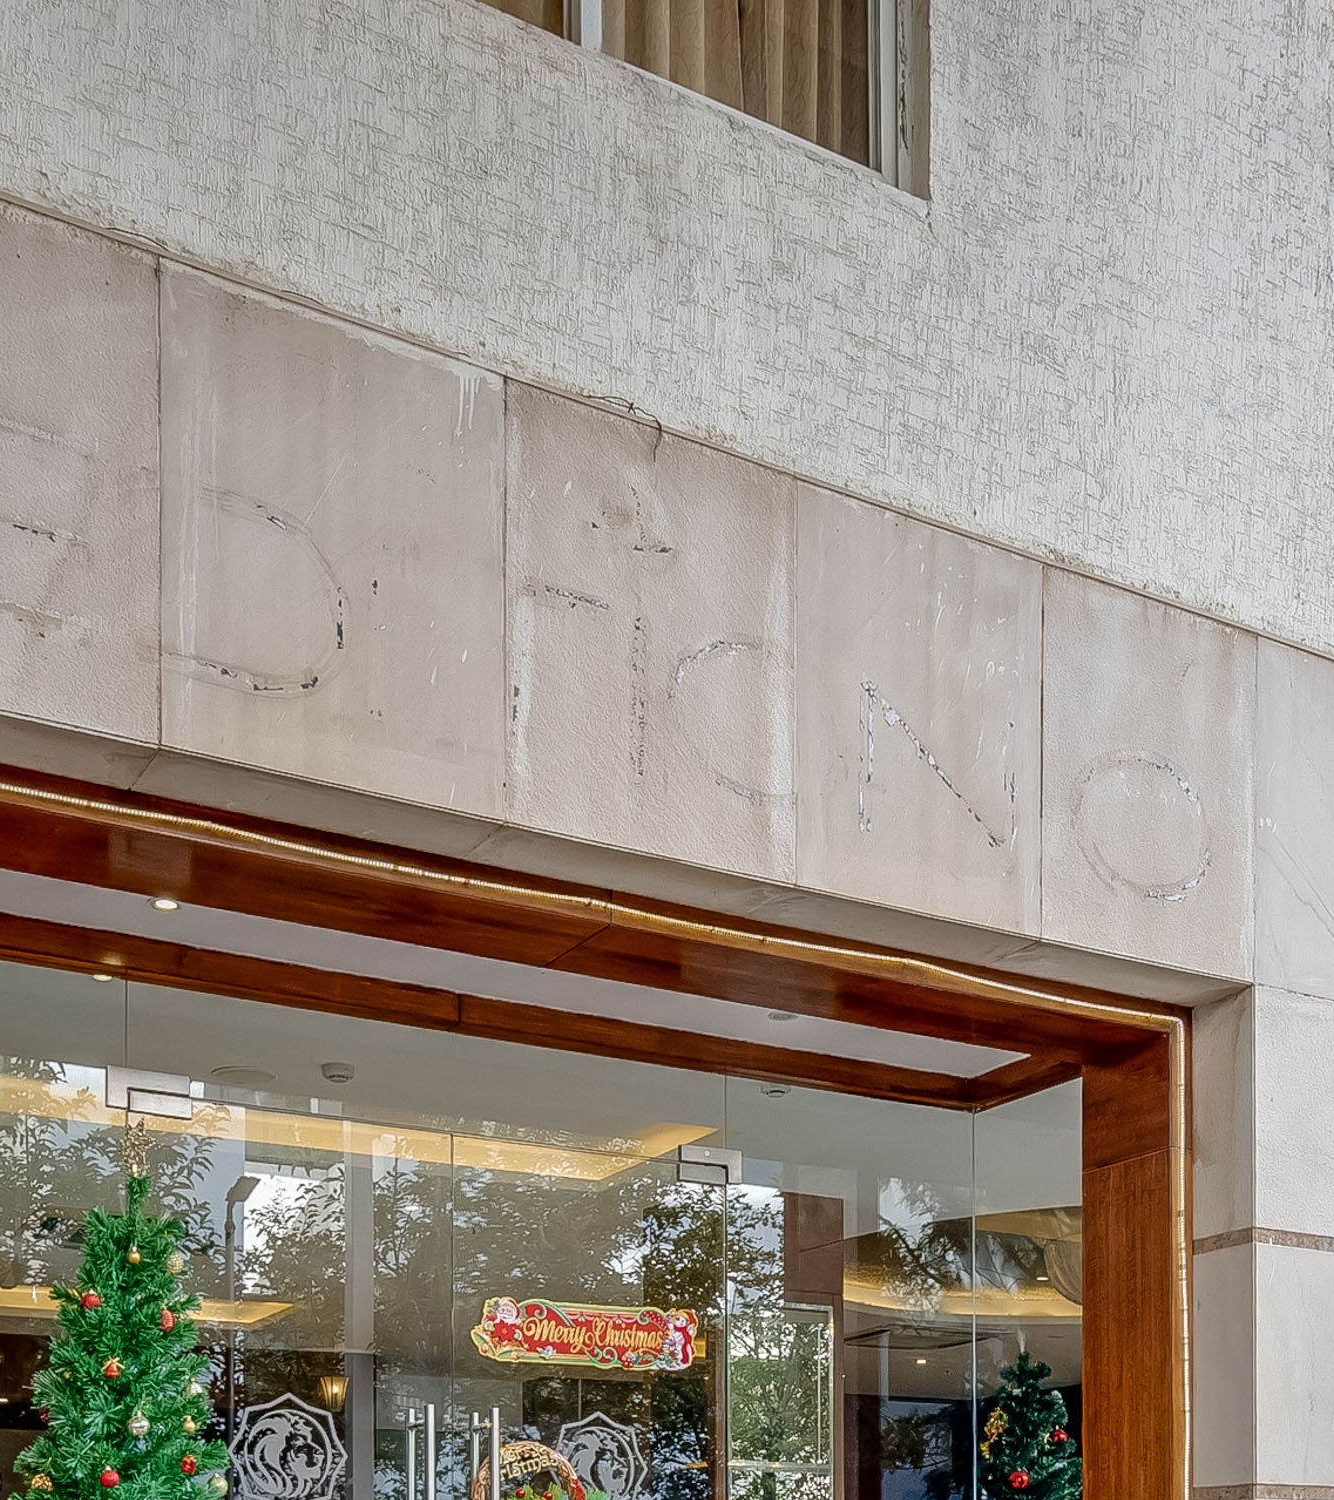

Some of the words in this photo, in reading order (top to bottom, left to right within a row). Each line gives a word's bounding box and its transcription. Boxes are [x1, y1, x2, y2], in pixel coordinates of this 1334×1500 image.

[523, 1317, 588, 1353] Merry
[585, 1317, 663, 1349] Christmas
[500, 1453, 559, 1481] ristmas
